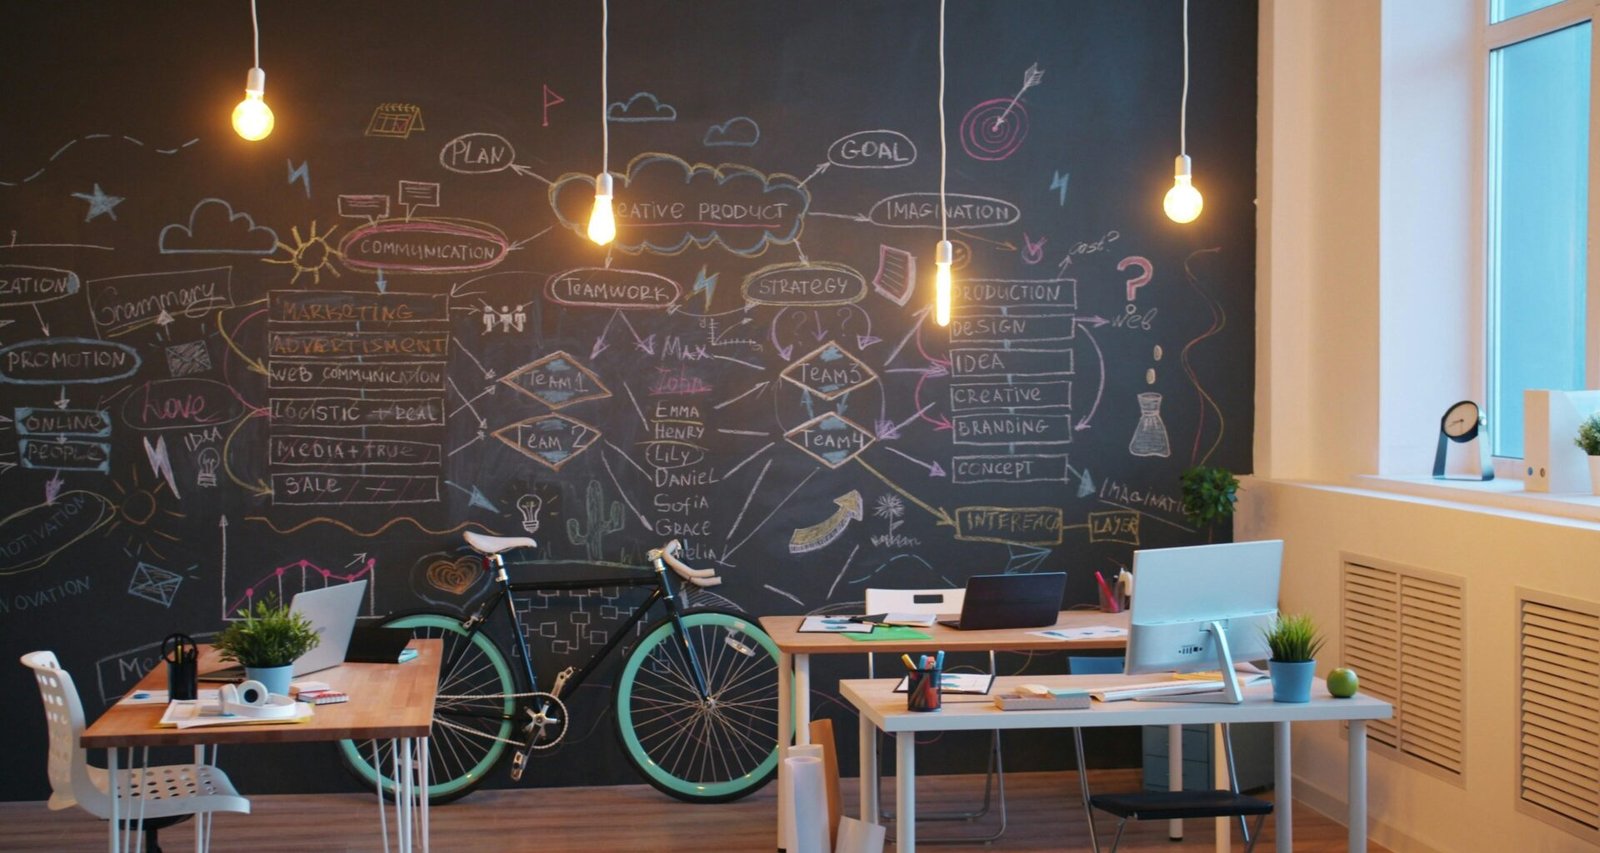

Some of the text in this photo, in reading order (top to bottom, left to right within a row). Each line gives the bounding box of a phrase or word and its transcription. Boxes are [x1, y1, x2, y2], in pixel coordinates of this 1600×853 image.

[452, 139, 505, 166] PLAN
[841, 139, 909, 162] GOAL
[614, 201, 789, 220] EATIVE PRODUCT
[886, 200, 1009, 220] IMAGINATION
[360, 239, 496, 261] COMMUNICATION
[282, 302, 414, 321] MARKETING
[8, 351, 126, 372] PROMOTION
[322, 364, 441, 385] COMMUNICATION
[656, 401, 700, 418] EMMA
[571, 424, 588, 449] 2
[958, 416, 1050, 437] BRANDING
